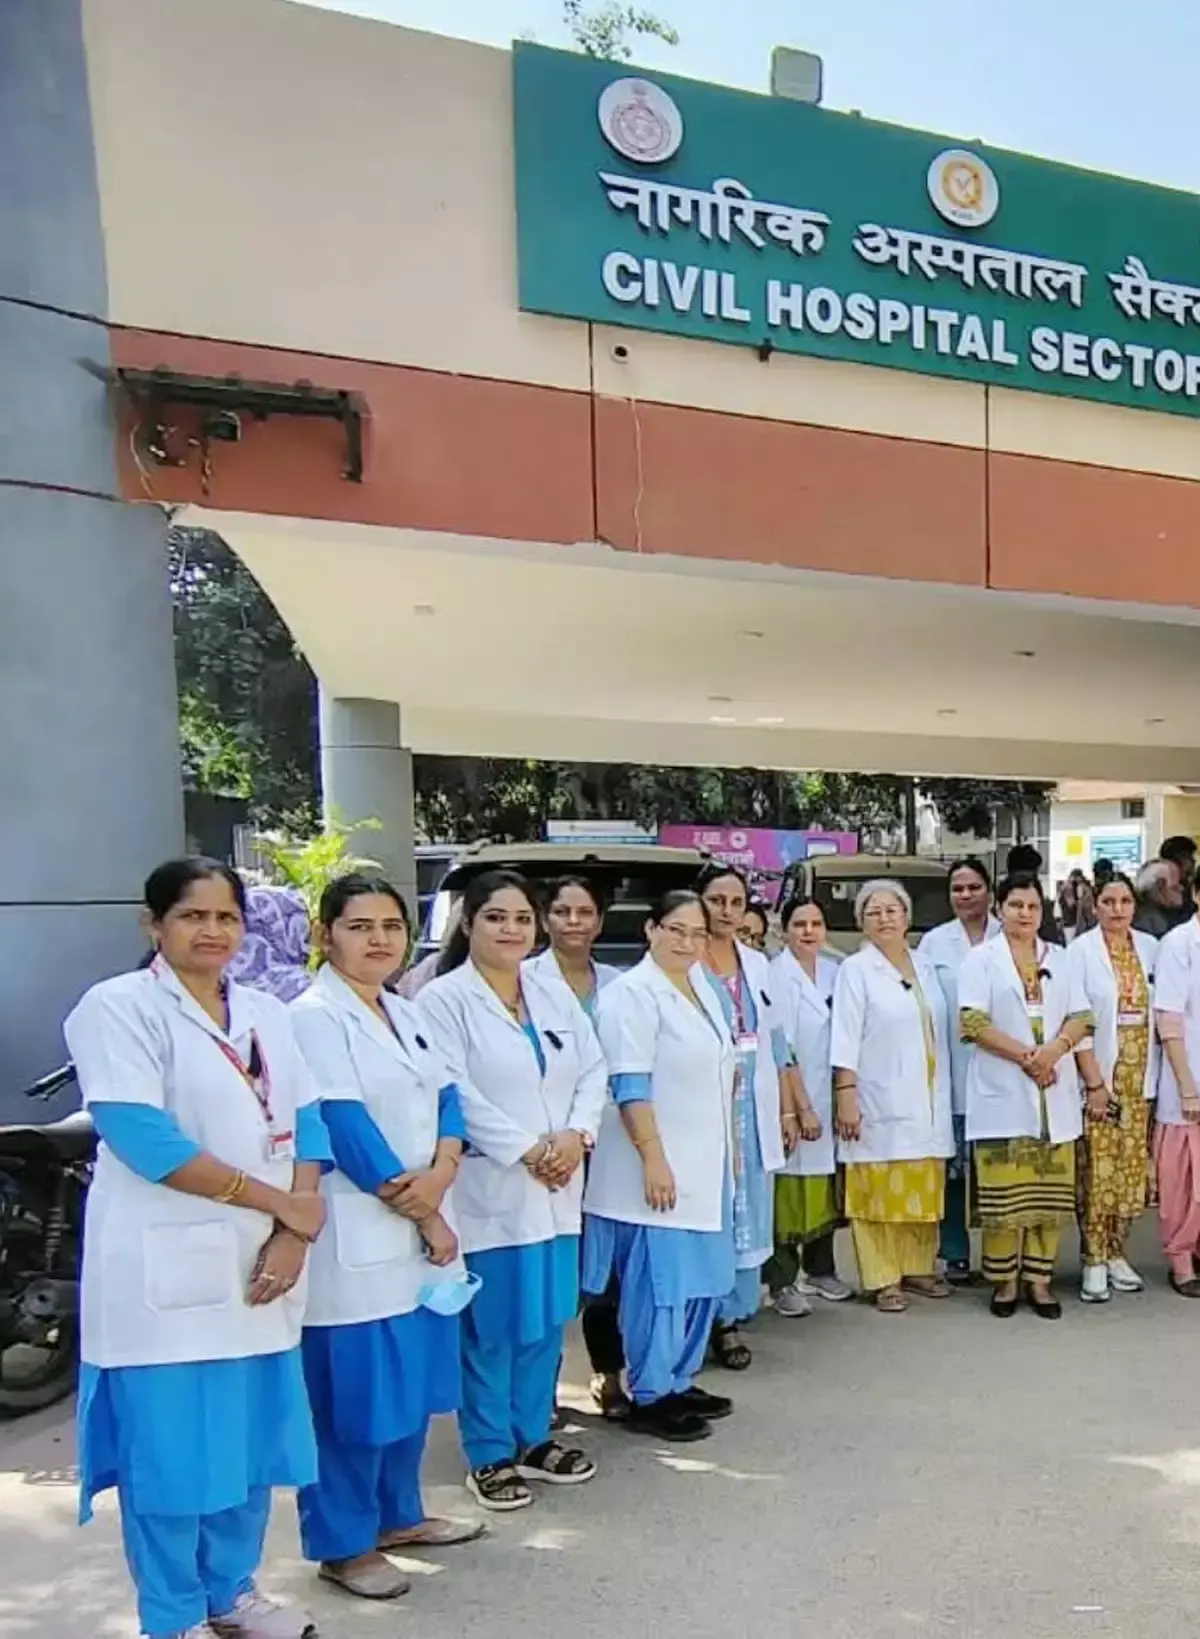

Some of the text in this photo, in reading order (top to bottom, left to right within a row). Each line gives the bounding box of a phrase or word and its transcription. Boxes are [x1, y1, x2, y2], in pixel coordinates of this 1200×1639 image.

[600, 172, 831, 255] नागरिक
[852, 222, 1087, 307] अस्पताल
[602, 251, 751, 322] CIVIL
[767, 280, 1018, 365] HOSPITAL
